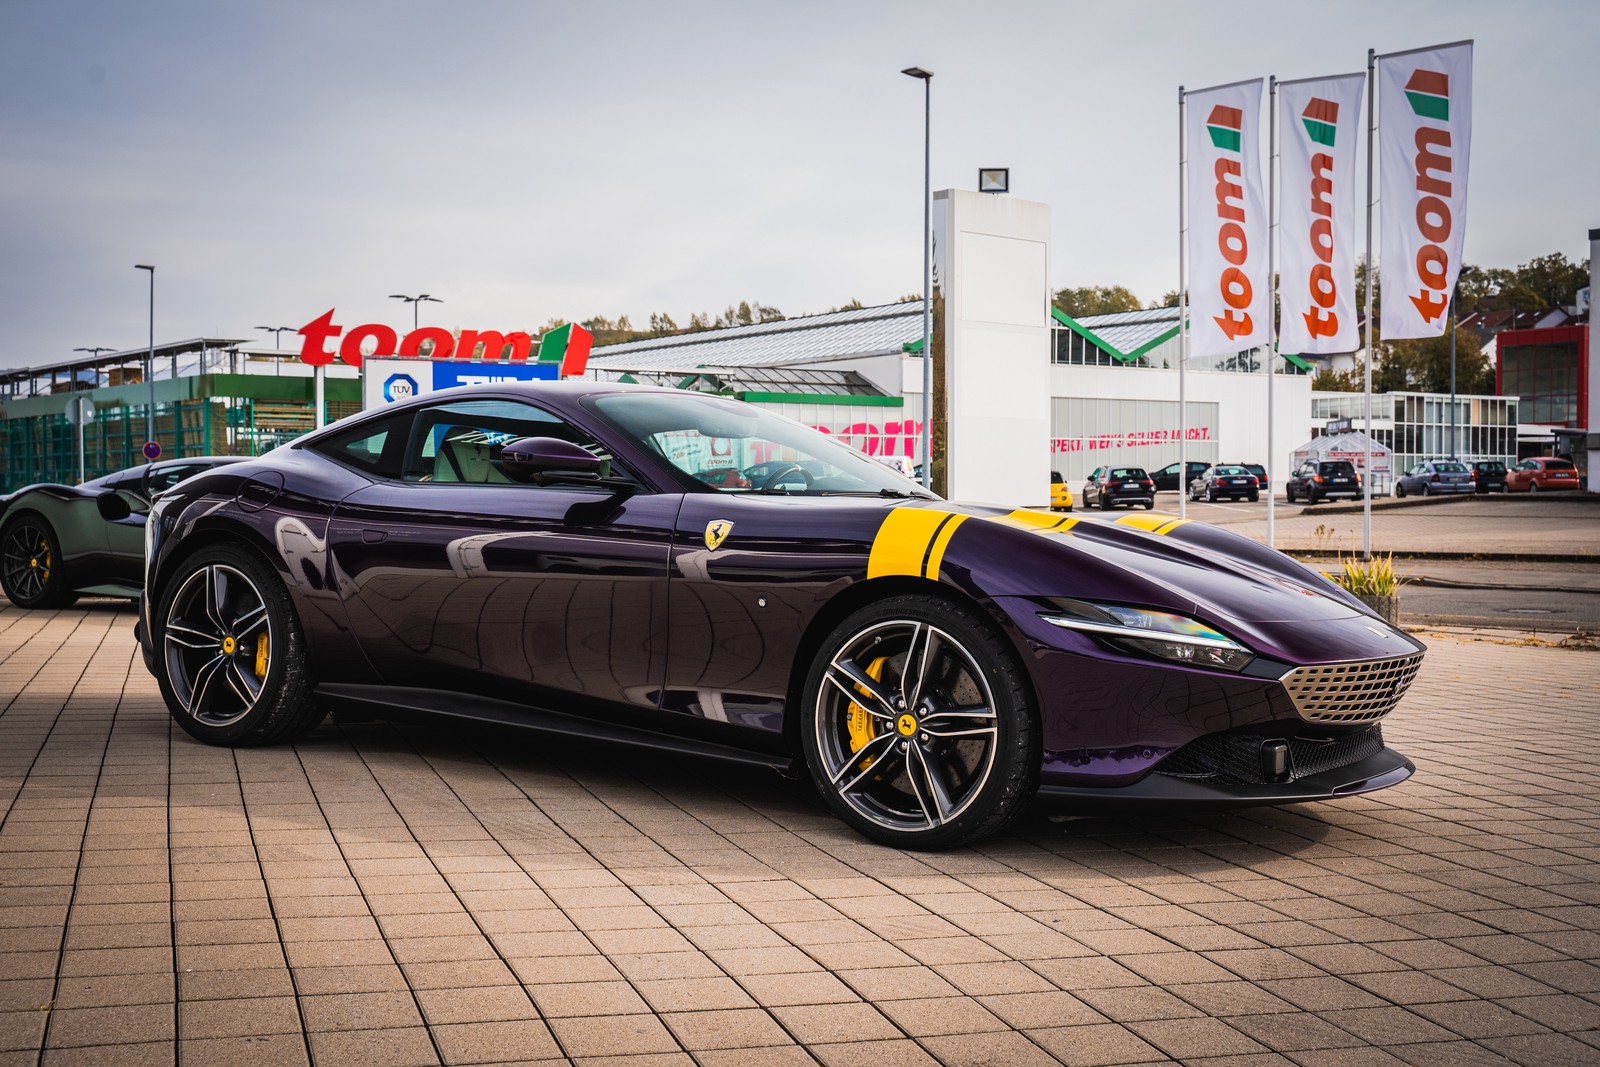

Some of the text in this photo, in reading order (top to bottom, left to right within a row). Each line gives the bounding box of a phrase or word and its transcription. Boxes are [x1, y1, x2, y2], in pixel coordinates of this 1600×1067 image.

[1213, 157, 1254, 341] toom
[1302, 152, 1339, 340] toom
[1407, 126, 1452, 324] toom
[297, 307, 532, 367] toom
[1170, 427, 1211, 444] MCHT.
